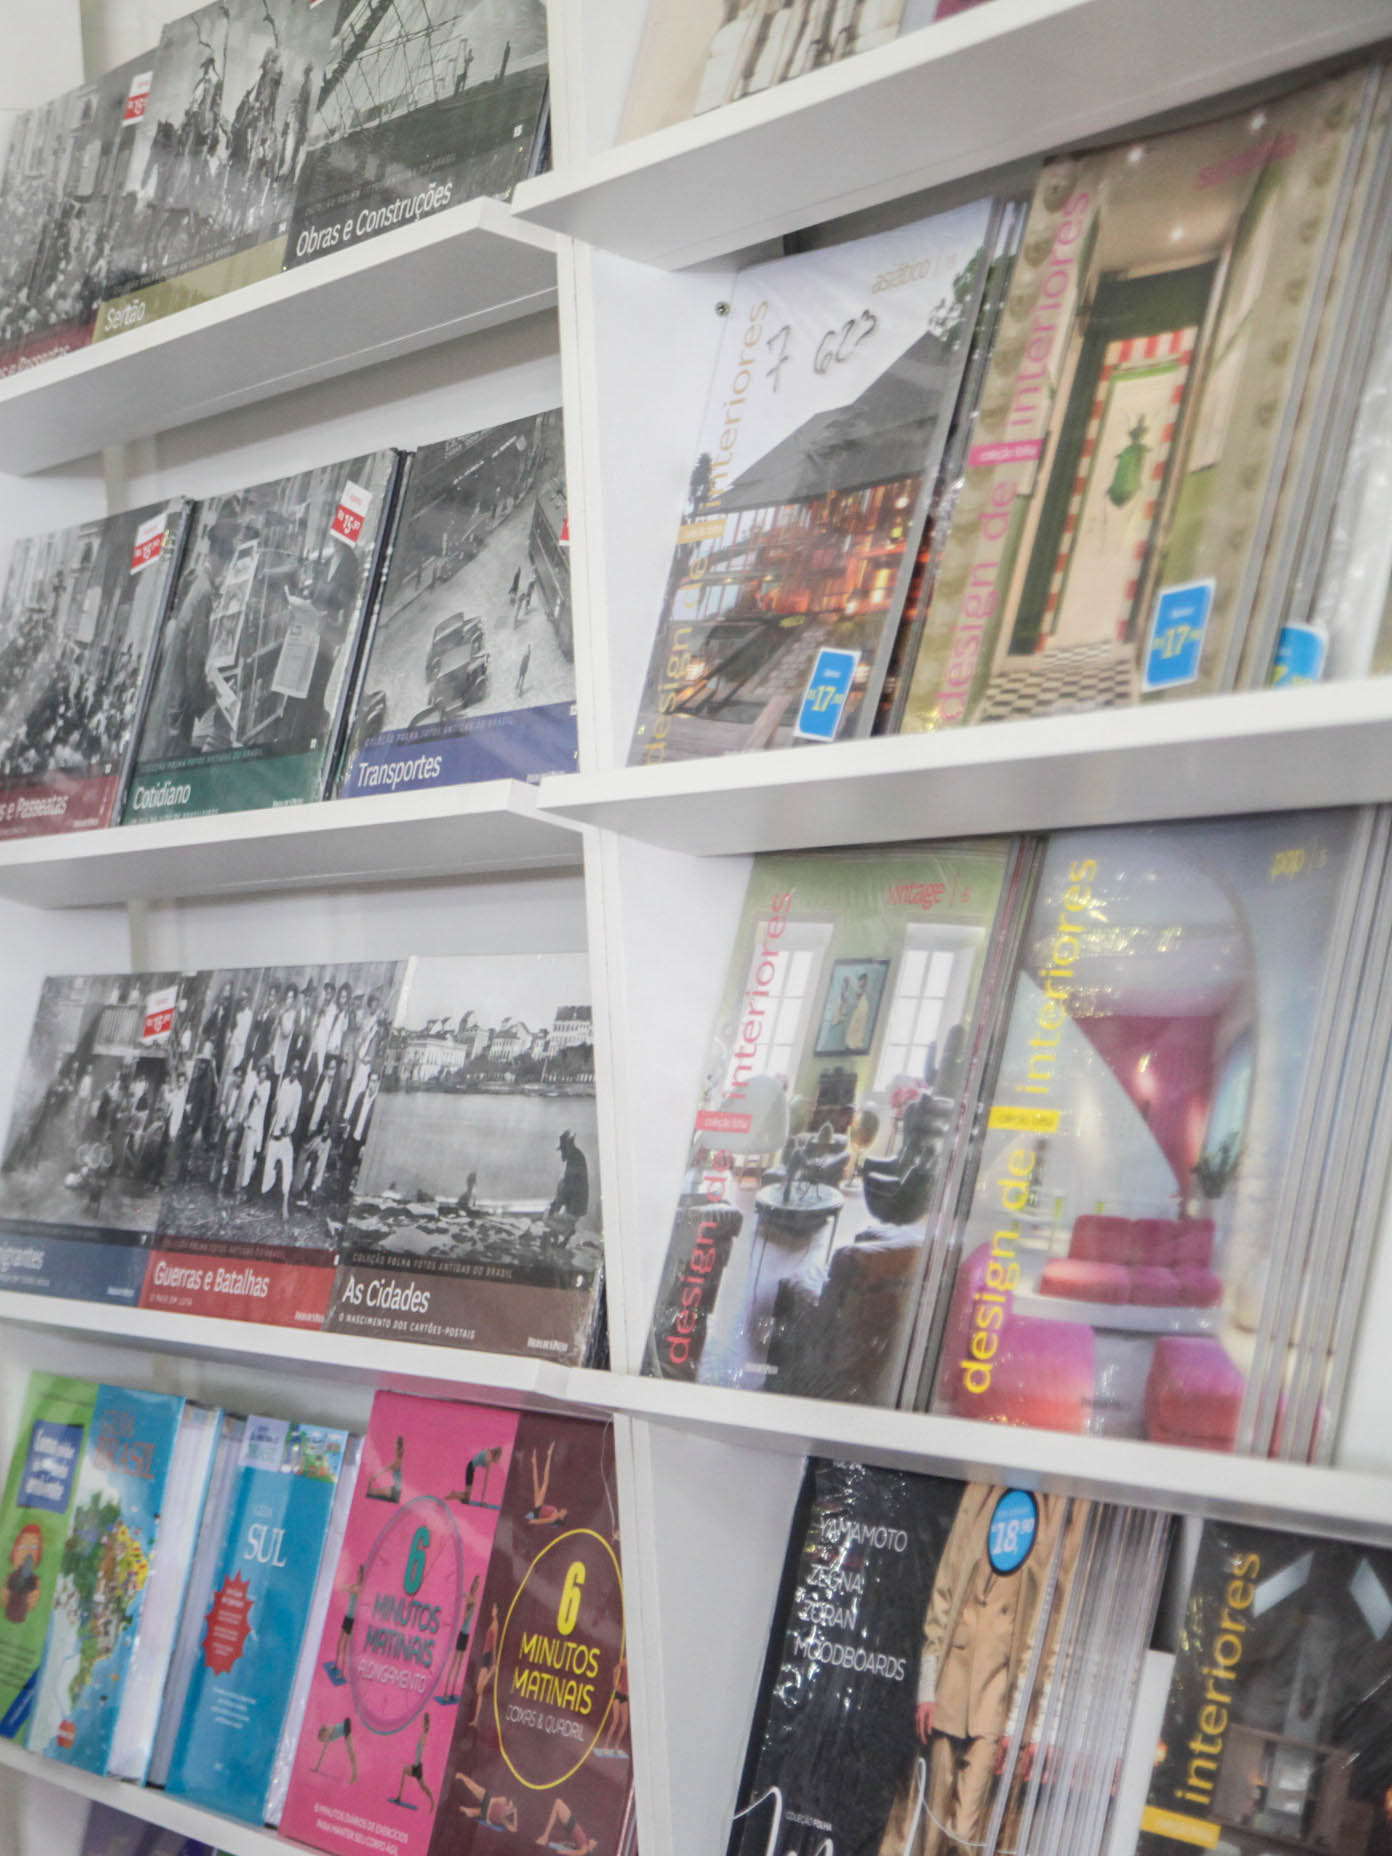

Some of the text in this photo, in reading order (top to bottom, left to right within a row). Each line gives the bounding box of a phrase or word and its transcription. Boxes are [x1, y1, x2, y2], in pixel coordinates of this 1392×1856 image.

[296, 180, 454, 257] Obras e Construções
[103, 299, 147, 332] Sertão
[698, 299, 770, 509] interiores
[934, 561, 1001, 722] design
[978, 480, 1018, 541] de
[1001, 191, 1092, 429] interiores
[1160, 624, 1192, 660] 17
[811, 685, 837, 713] 17
[358, 754, 443, 791] Transportes
[132, 780, 192, 811] Cotidiano
[1014, 858, 1098, 1095] interiores
[665, 1220, 720, 1365] design
[703, 1149, 736, 1203] de
[721, 891, 794, 1101] interiores
[998, 1147, 1037, 1212] de
[154, 1260, 270, 1298] Guerras e Batalhas
[386, 1255, 412, 1268] FOLHA
[413, 1258, 437, 1272] FOTOS
[437, 1261, 471, 1275] ANTIGAS
[472, 1265, 485, 1277] DO
[341, 1274, 431, 1314] As Cidades
[960, 1228, 1023, 1395] design
[338, 1313, 346, 1323] O
[347, 1315, 391, 1329] NASCIMENTO
[392, 1320, 408, 1332] DOS
[409, 1321, 476, 1341] CARTÕES-POSTAIS
[94, 1435, 156, 1481] BRASIL
[242, 1522, 288, 1568] SUL
[820, 1516, 908, 1553] YAMAMOTO
[403, 1525, 431, 1597] 6
[807, 1564, 864, 1596] ZEGNA
[372, 1592, 441, 1634] MINUTOS
[556, 1560, 587, 1636] 6
[804, 1600, 857, 1631] ZORAN
[363, 1624, 436, 1669] MATINAIS
[518, 1631, 601, 1679] MINUTOS
[794, 1635, 907, 1682] MOODBOARDS
[358, 1657, 428, 1694] ALONGAMENTO
[510, 1666, 595, 1715] MATINAIS
[1173, 1551, 1262, 1805] interiores
[505, 1704, 585, 1742] COXAS & QUADRIL
